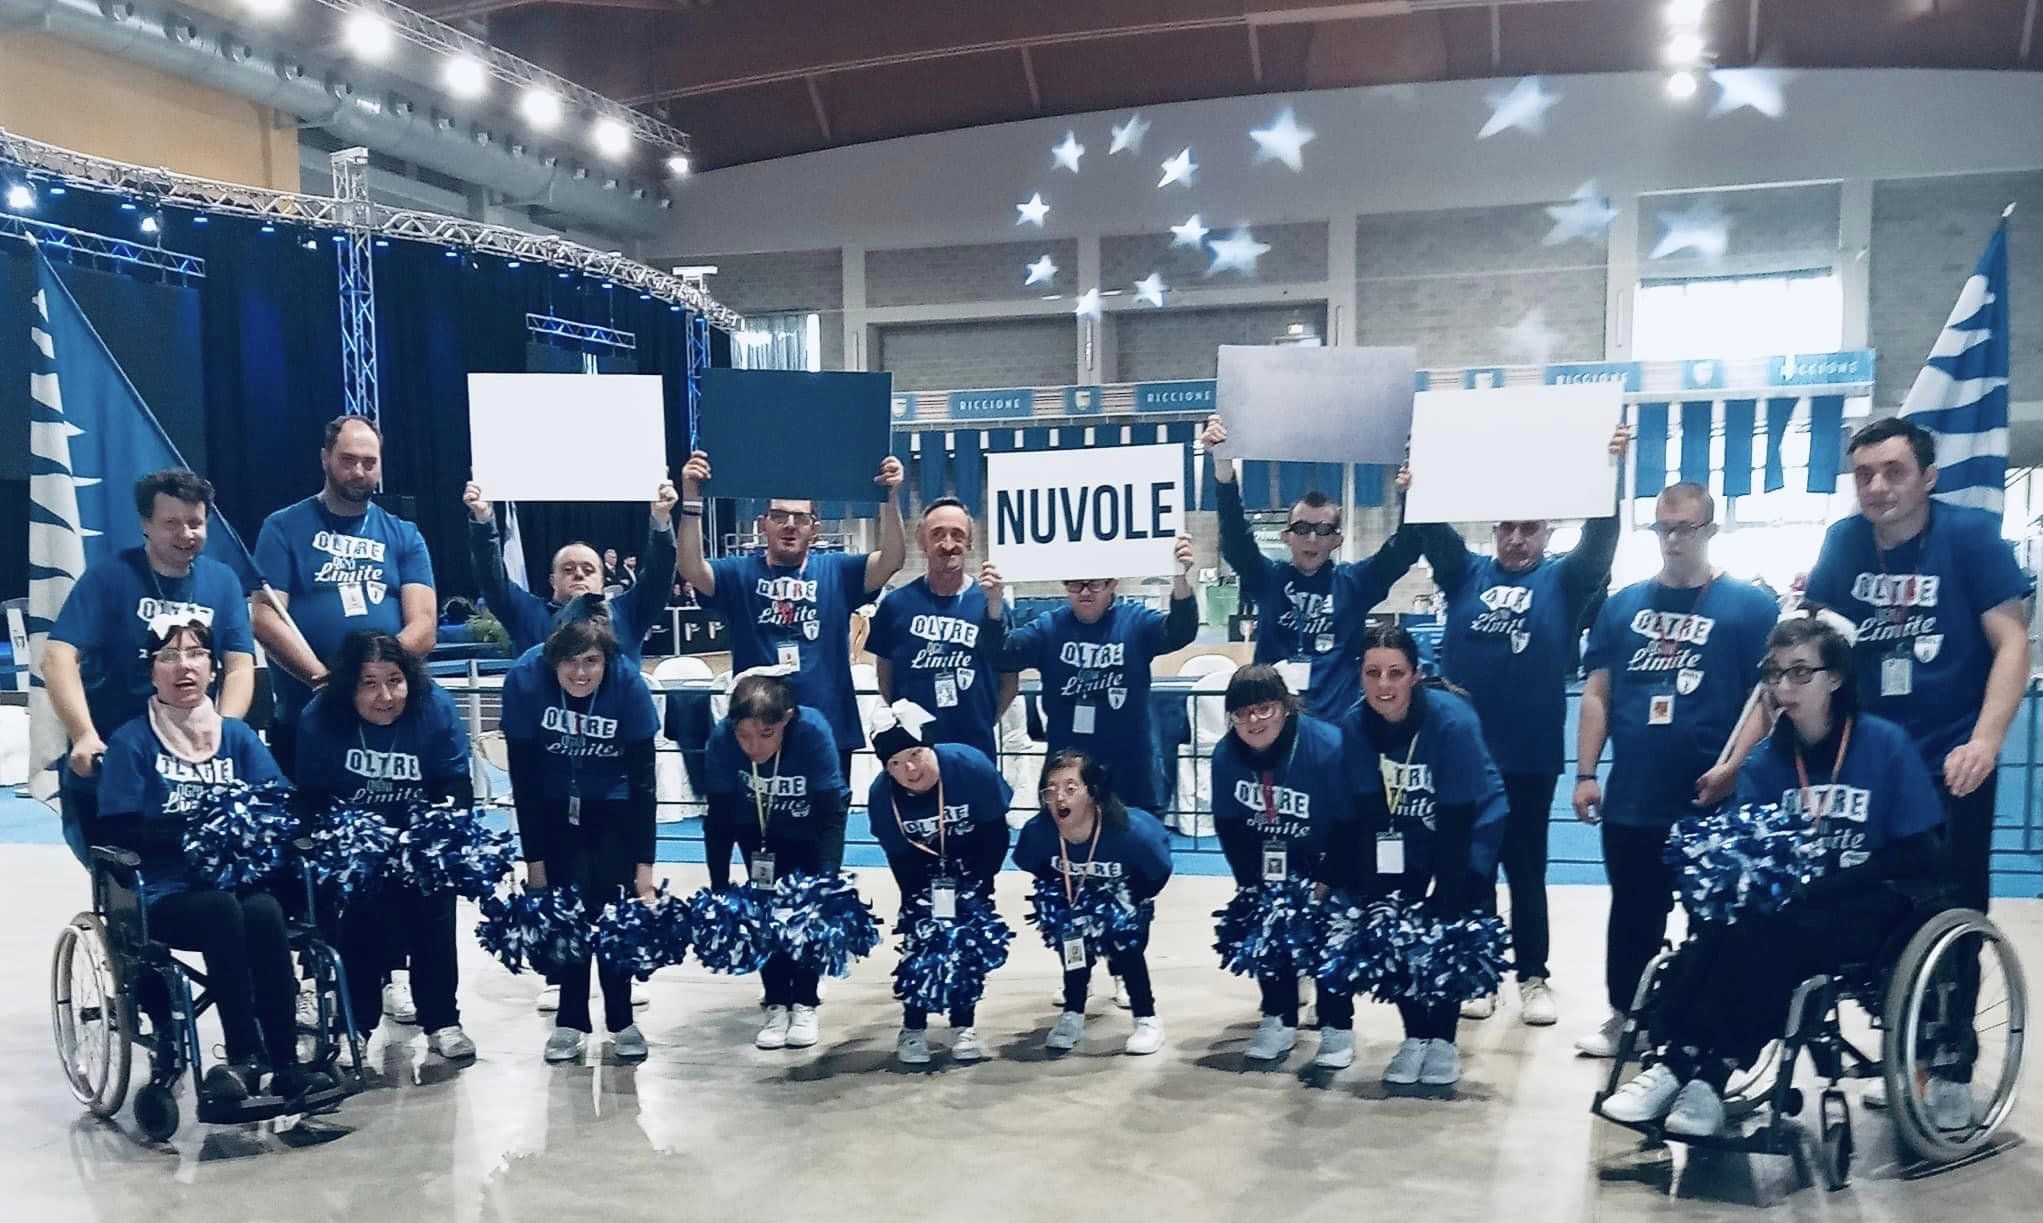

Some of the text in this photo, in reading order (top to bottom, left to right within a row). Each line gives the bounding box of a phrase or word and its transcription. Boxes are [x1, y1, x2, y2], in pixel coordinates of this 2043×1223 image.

[959, 398, 1020, 410] RICCIONE
[1147, 391, 1211, 402] RICCIONE
[997, 481, 1176, 545] NUVOLE
[313, 531, 384, 561] OLTRE
[314, 562, 383, 582] Limite
[756, 577, 817, 602] OLTRE
[910, 615, 979, 648] OLTRE
[1631, 610, 1715, 645] OLTRE
[1855, 615, 1937, 641] Limite
[911, 650, 972, 669] Limite
[1060, 642, 1124, 668] OLTRE
[1627, 648, 1702, 671] Limite
[541, 706, 618, 738] OLTRE
[545, 743, 619, 757] Limite
[345, 748, 421, 780] OLTRE
[350, 787, 422, 804] Limite
